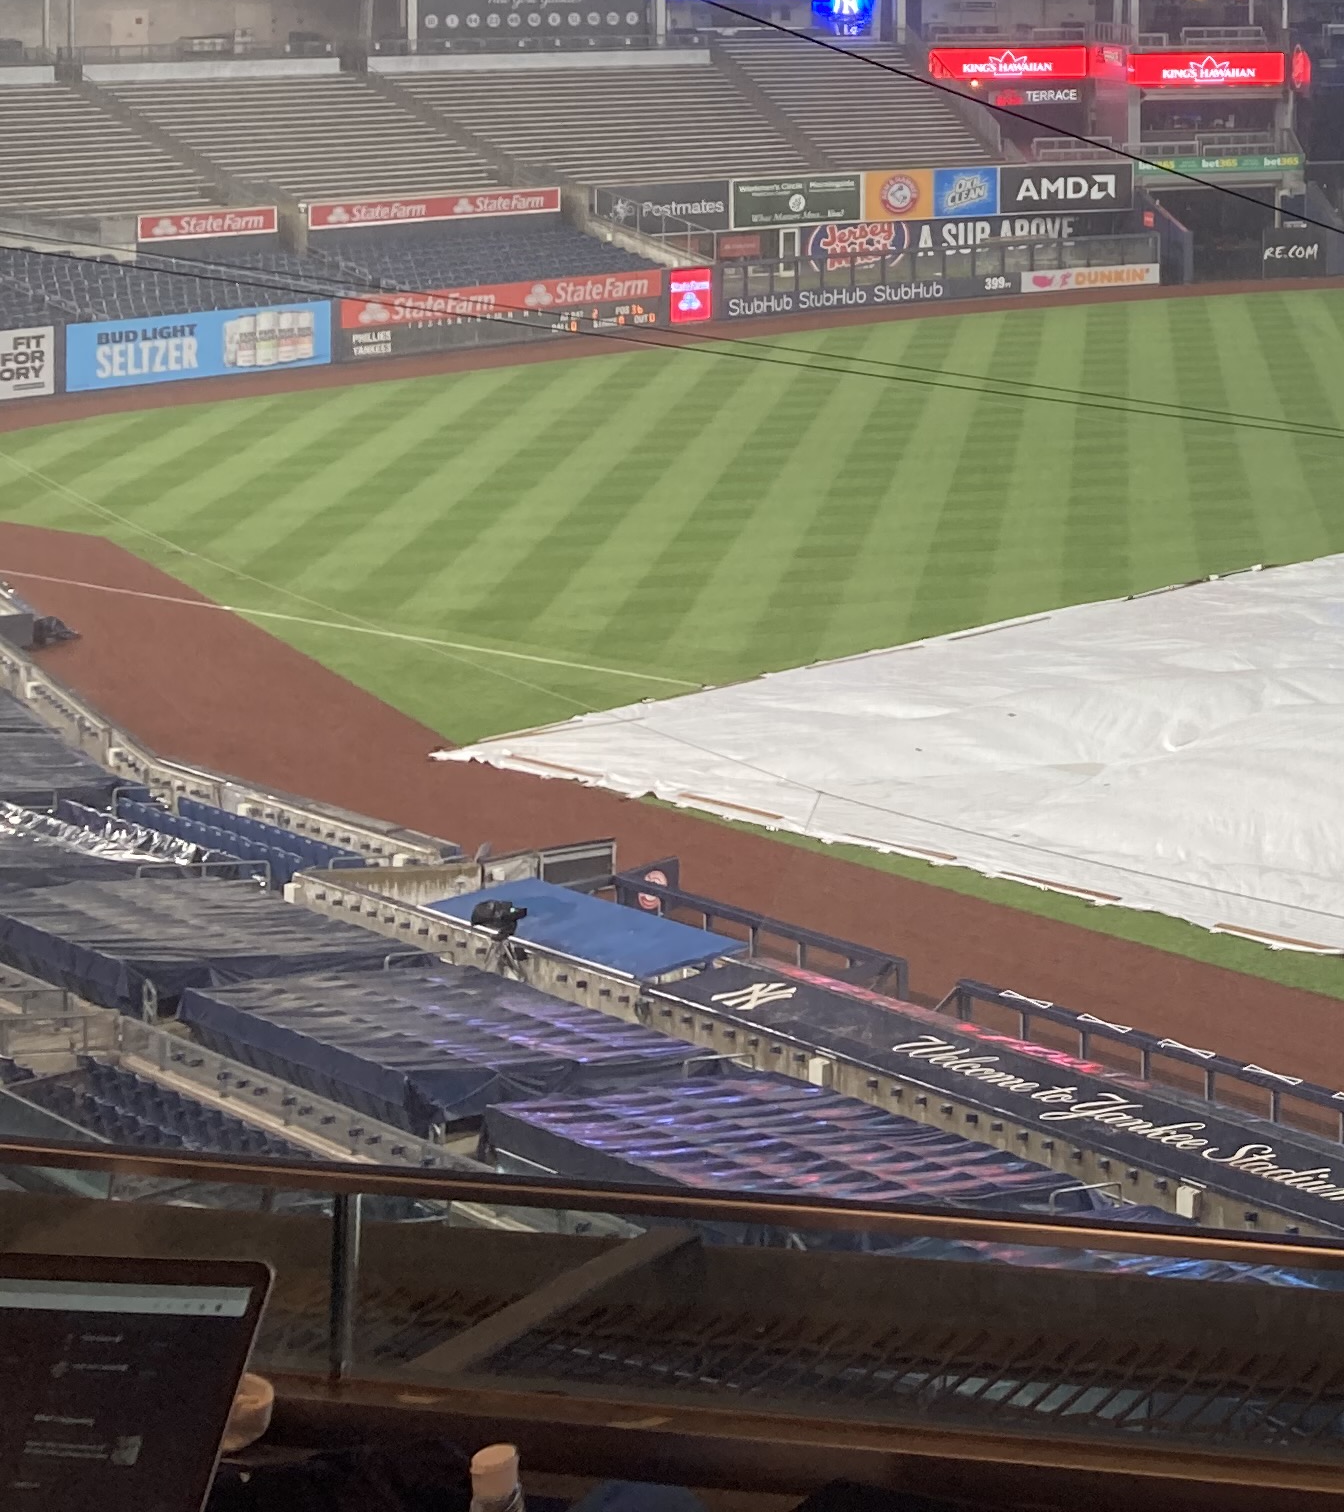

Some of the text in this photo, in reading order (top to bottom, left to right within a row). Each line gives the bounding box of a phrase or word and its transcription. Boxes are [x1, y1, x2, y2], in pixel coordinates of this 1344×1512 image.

[1026, 90, 1077, 101] TERRACE
[1016, 177, 1087, 201] AMD
[642, 199, 724, 217] Postmates
[820, 223, 895, 248] Jersey
[918, 225, 934, 256] A
[1263, 244, 1319, 259] RE.COM
[984, 277, 1004, 291] 399
[1074, 268, 1150, 286] DUNKIN'
[729, 282, 943, 316] StubHub StubHub StubHub
[13, 335, 45, 351] FIT
[97, 323, 198, 345] BUD LIGHT
[1, 350, 45, 365] FOR
[96, 337, 198, 378] SELTZER
[892, 1035, 1039, 1093] Welcome
[1031, 1086, 1078, 1104] to
[1039, 1092, 1210, 1151] Yankee
